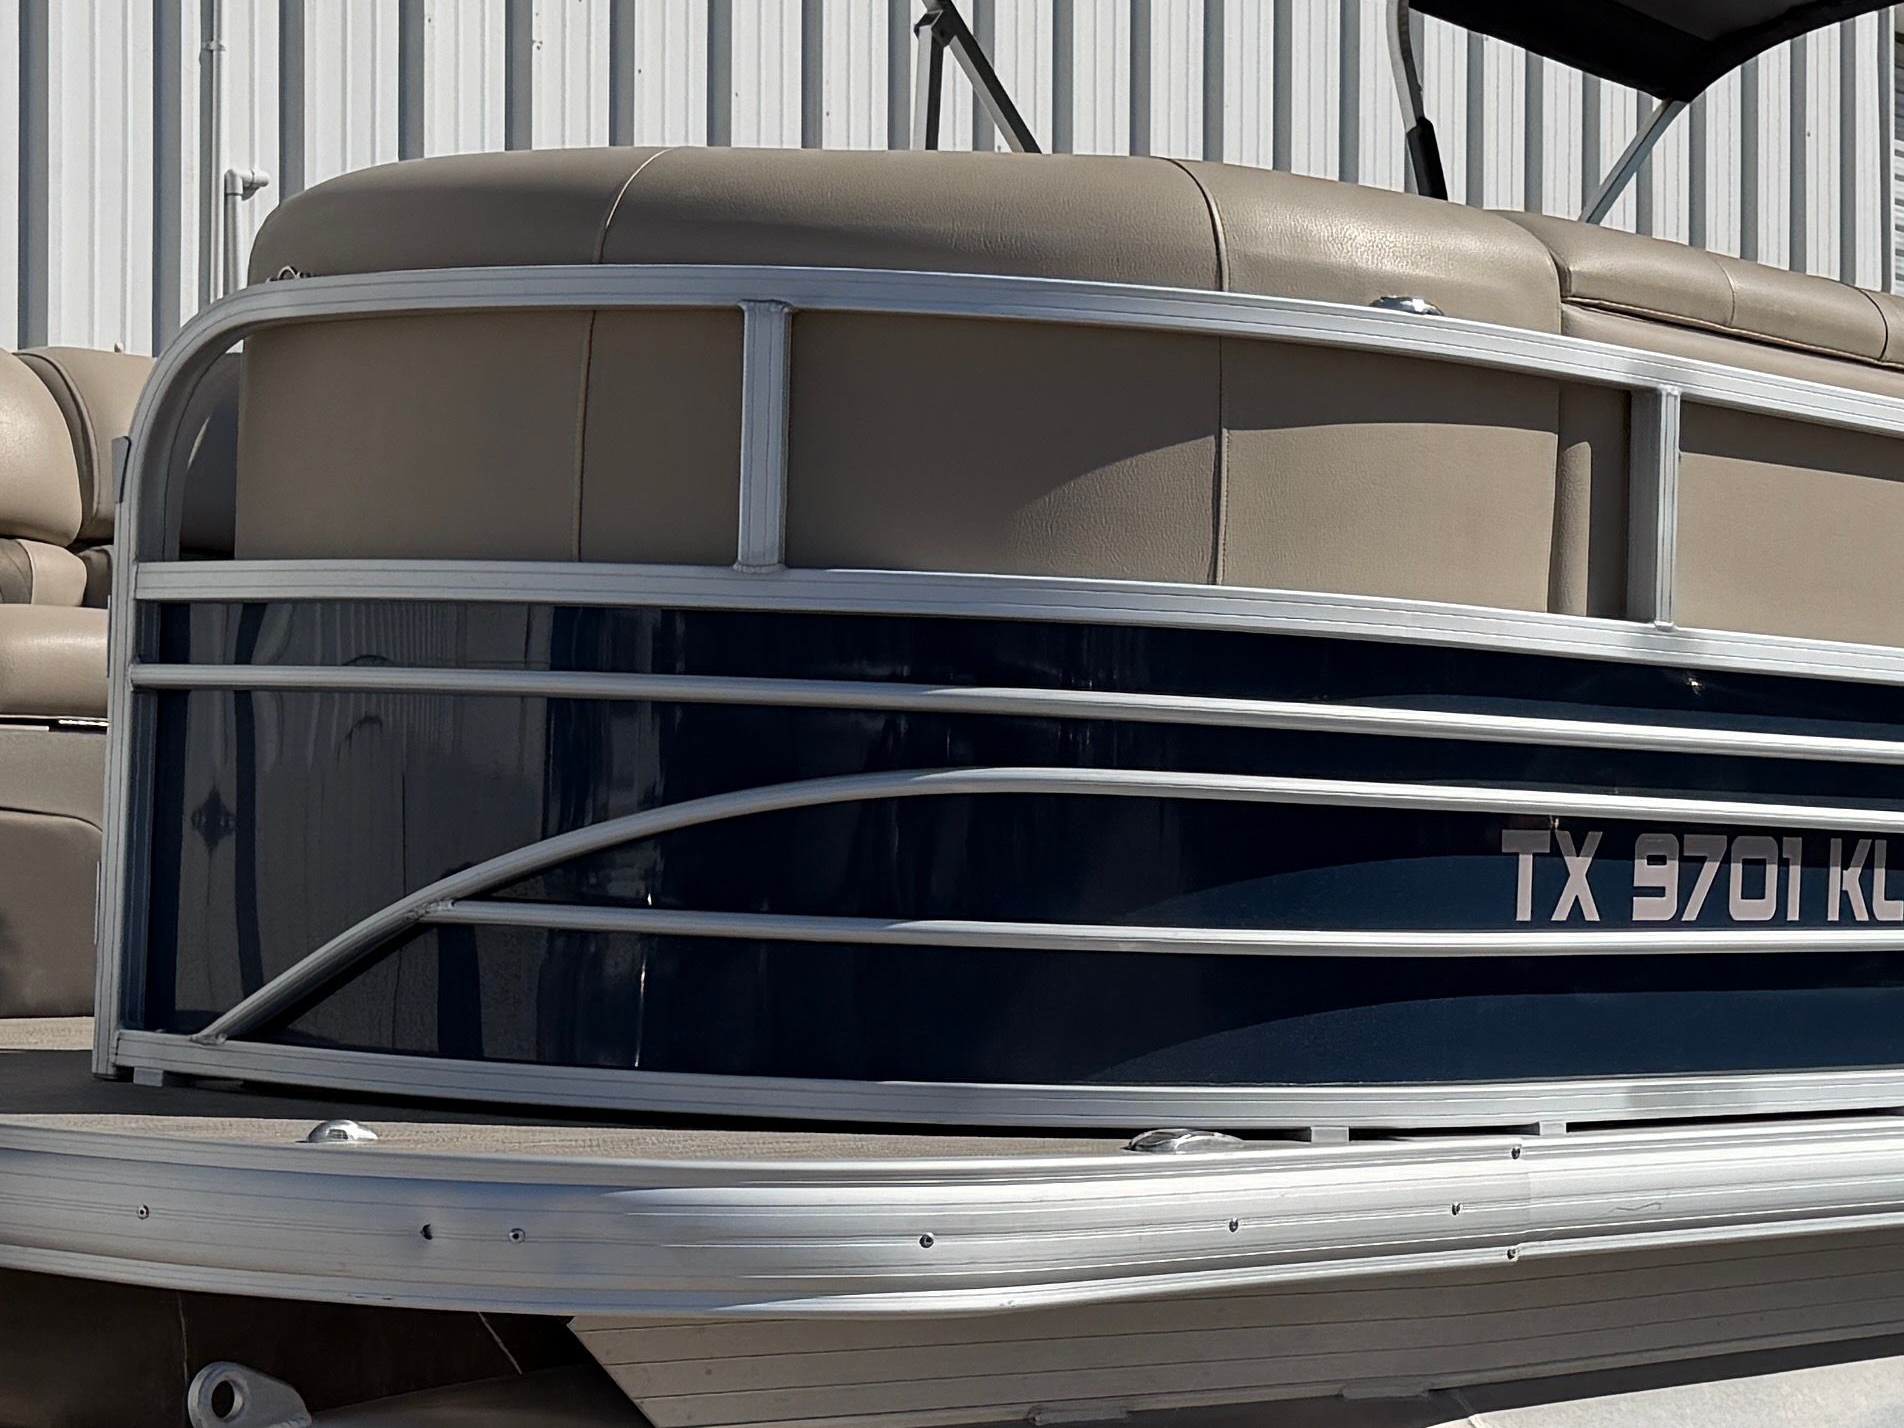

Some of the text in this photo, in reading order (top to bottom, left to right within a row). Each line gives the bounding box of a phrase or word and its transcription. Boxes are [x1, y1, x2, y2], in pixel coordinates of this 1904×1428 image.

[1501, 829, 1603, 922] TX
[1631, 832, 1803, 922] 9701
[1827, 837, 1904, 922] KL
